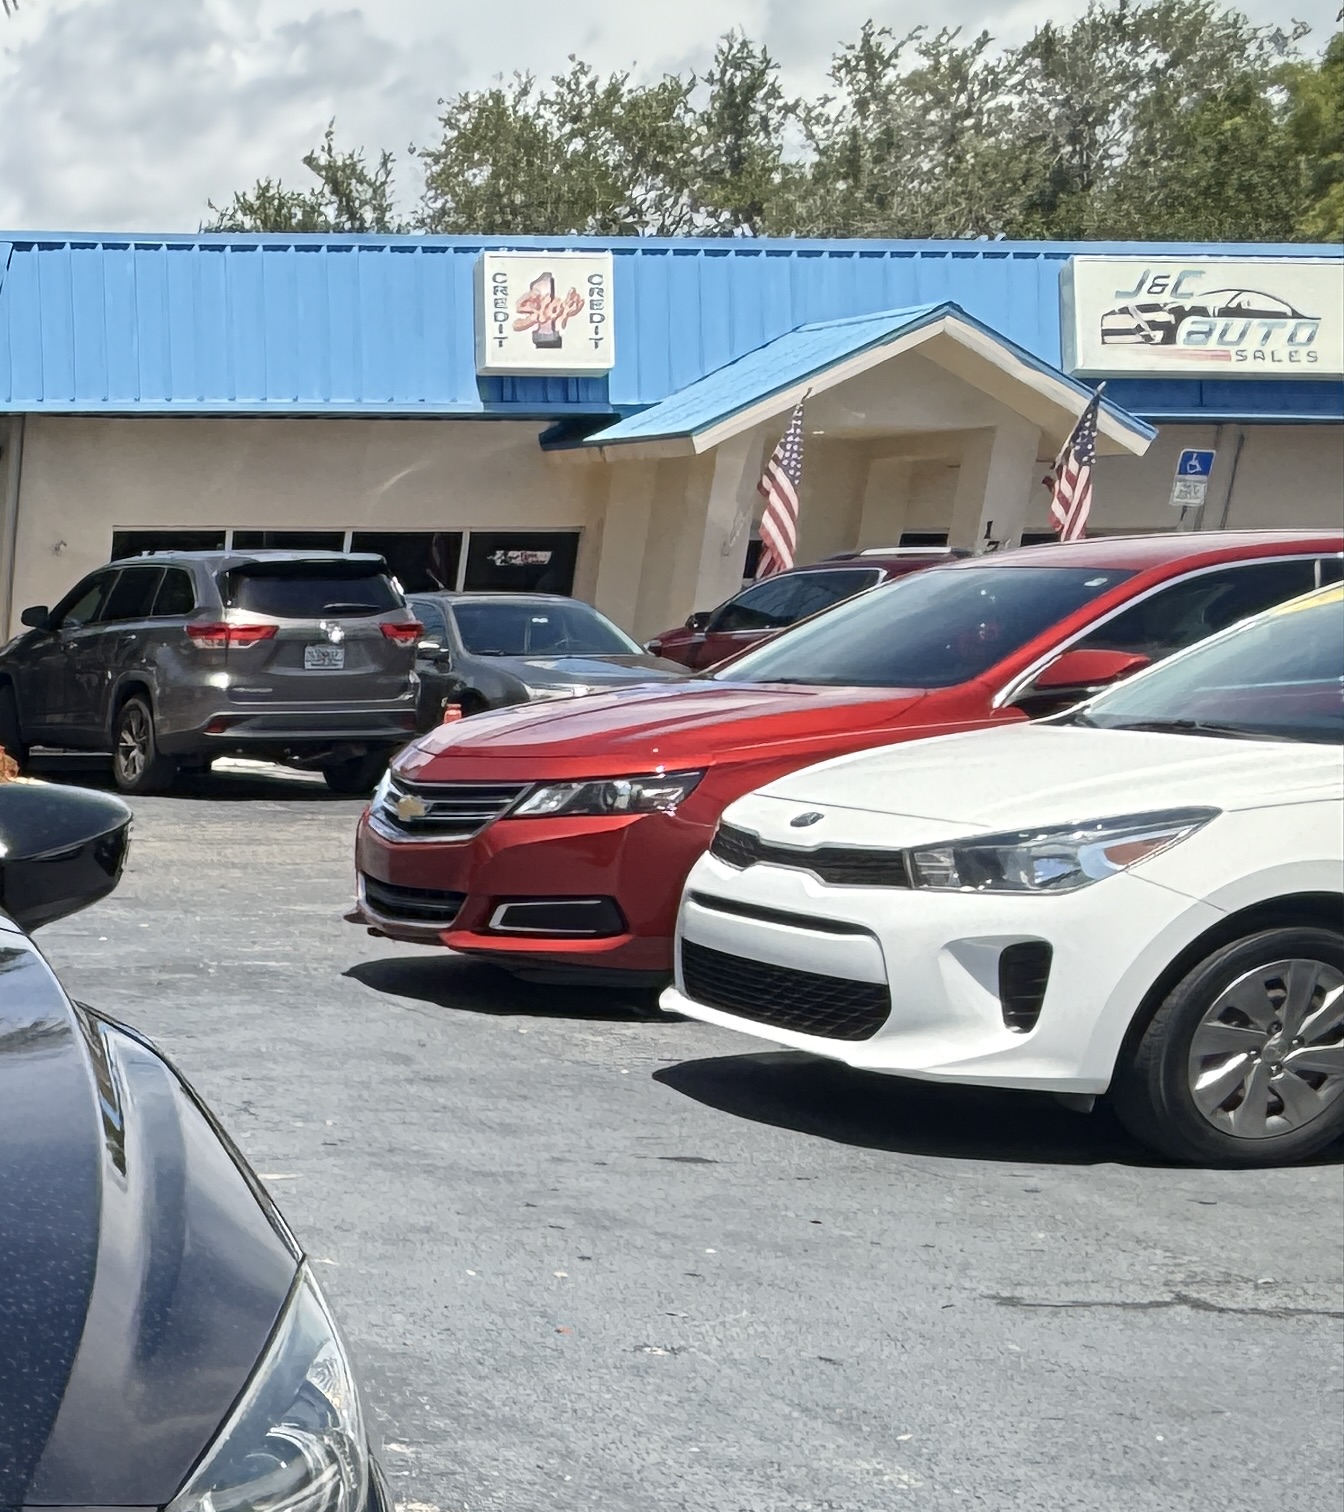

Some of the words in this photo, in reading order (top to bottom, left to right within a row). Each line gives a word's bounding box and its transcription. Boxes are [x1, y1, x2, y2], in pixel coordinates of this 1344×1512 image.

[492, 272, 510, 348] CREDIT
[1115, 269, 1206, 299] J&C
[587, 273, 606, 349] CREDIT
[1235, 349, 1319, 363] SALES
